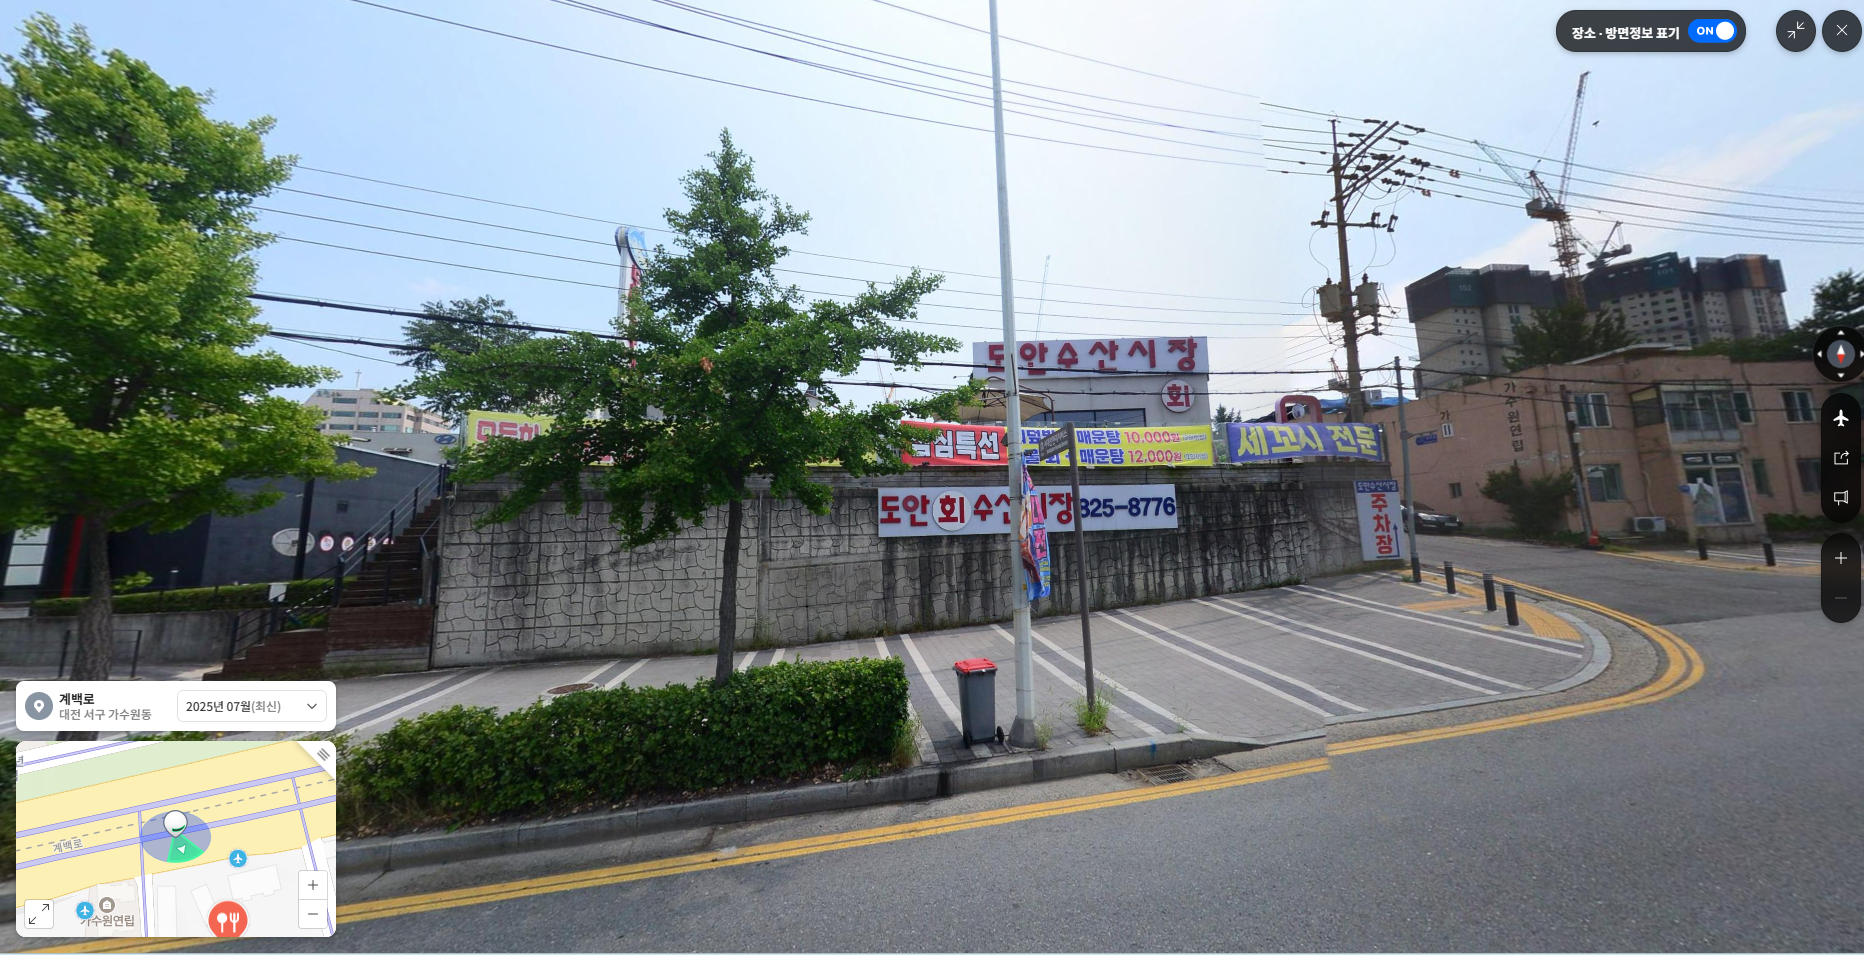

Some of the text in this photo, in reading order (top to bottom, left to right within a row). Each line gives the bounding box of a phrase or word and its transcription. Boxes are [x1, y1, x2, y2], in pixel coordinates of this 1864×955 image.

[988, 337, 1197, 375] 도안수산시장
[1166, 384, 1190, 407] 회
[1504, 382, 1523, 452] 가수원연립
[1077, 430, 1121, 444] 매운탕
[1238, 425, 1377, 456] 세꼬시 전문
[1080, 449, 1124, 464] 매운탕
[1128, 450, 1182, 462] 12,000원
[1358, 482, 1396, 491] 도안수산시장
[880, 495, 930, 526] 도안
[938, 497, 965, 523] 회
[1080, 497, 1176, 517] 825-8776
[1371, 494, 1393, 554] 주차장
